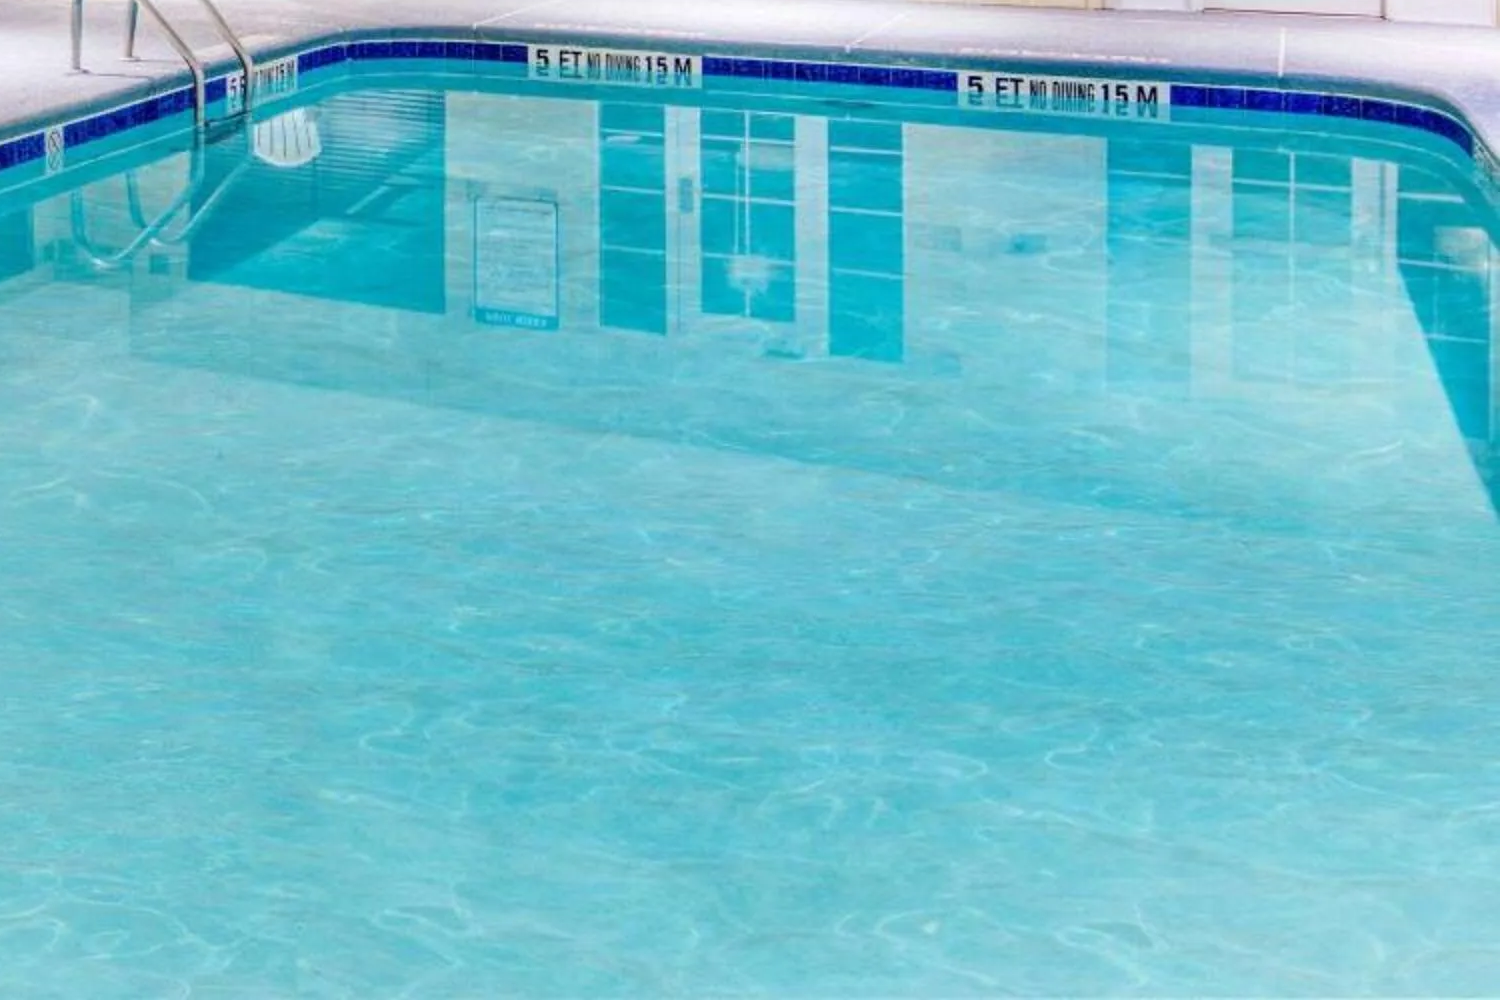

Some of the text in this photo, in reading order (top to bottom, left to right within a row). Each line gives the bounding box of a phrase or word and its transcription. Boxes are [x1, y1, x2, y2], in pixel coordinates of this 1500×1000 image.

[536, 48, 550, 69] 5
[967, 75, 984, 95] 5
[995, 77, 1024, 96] FT
[1029, 79, 1047, 98] NO
[1052, 80, 1095, 102] DIVING
